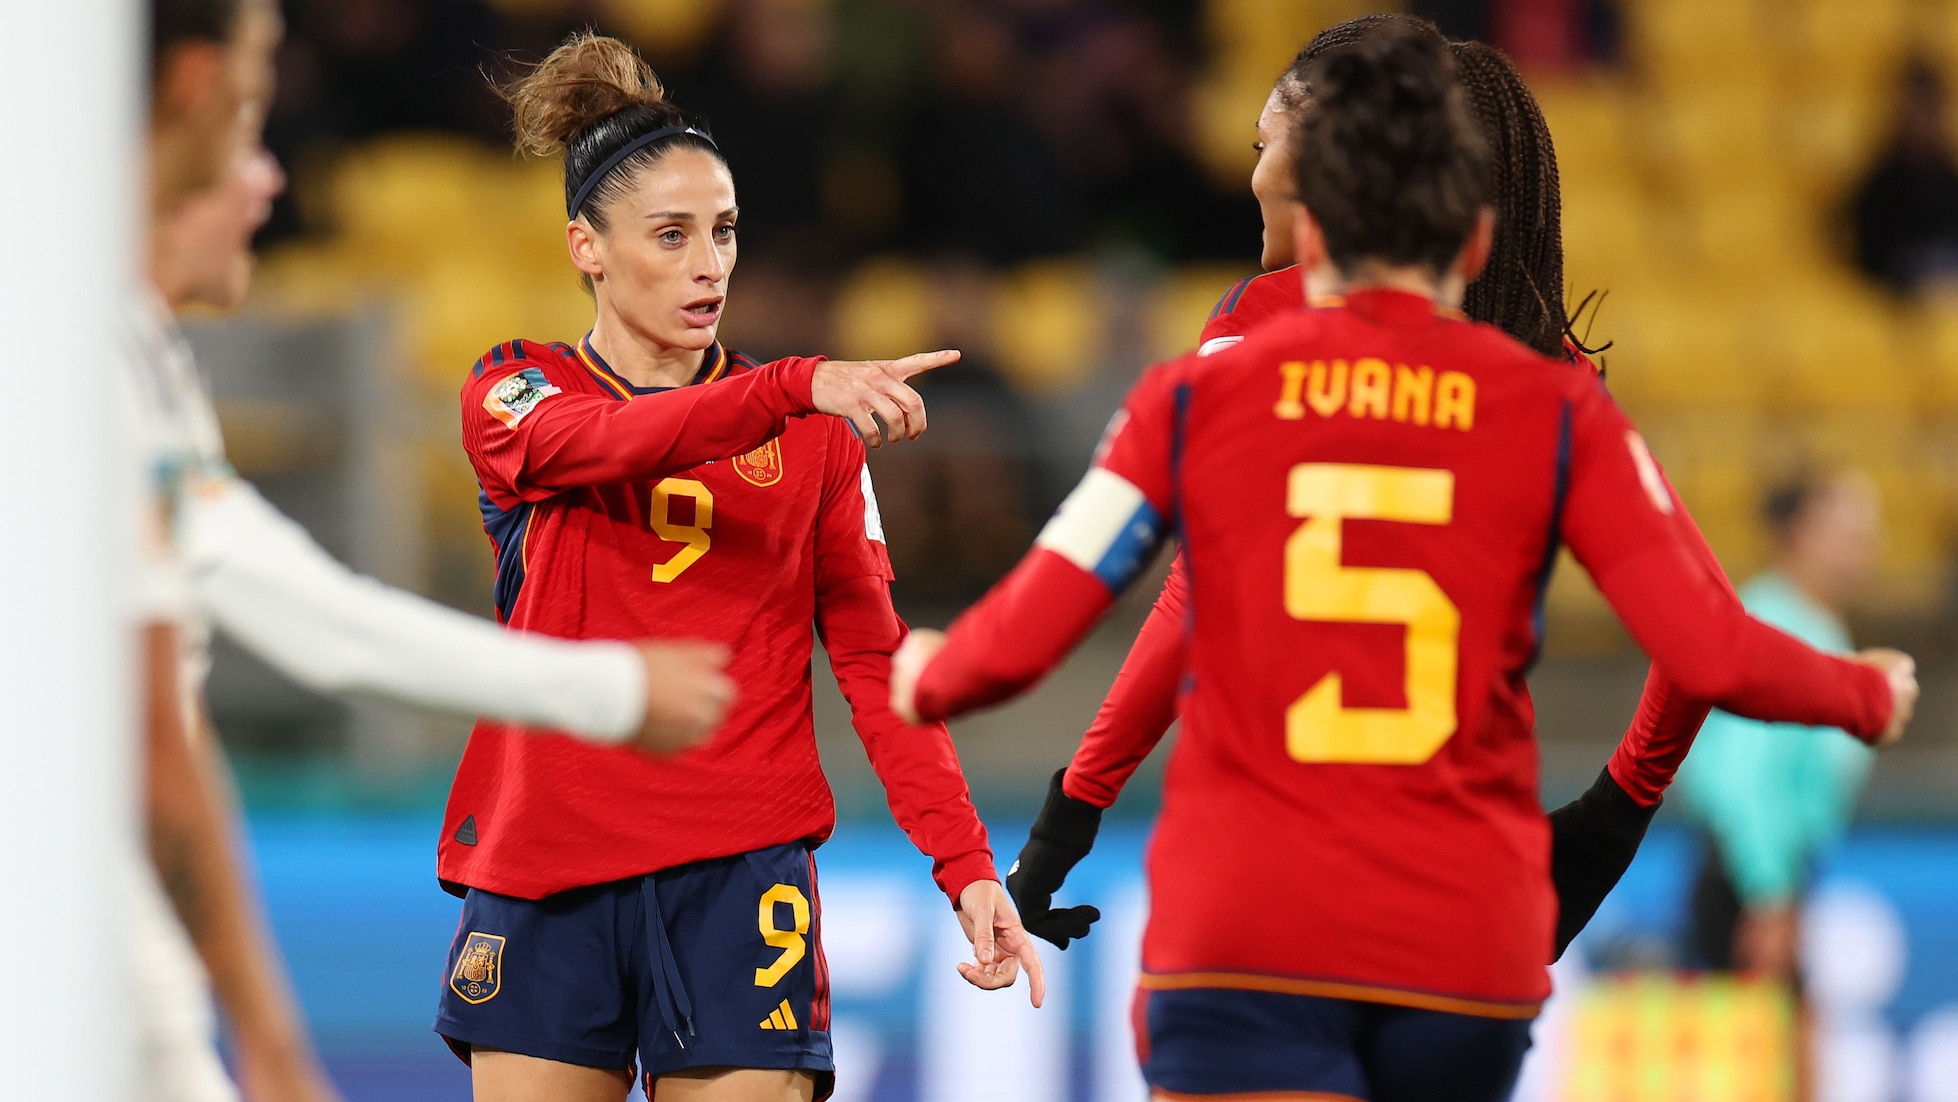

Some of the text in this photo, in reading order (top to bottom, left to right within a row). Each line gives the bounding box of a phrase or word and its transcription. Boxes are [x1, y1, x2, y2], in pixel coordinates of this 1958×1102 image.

[1273, 357, 1476, 431] IVANA
[650, 477, 713, 583] 9
[1285, 463, 1461, 765] 5
[754, 883, 811, 988] 9
